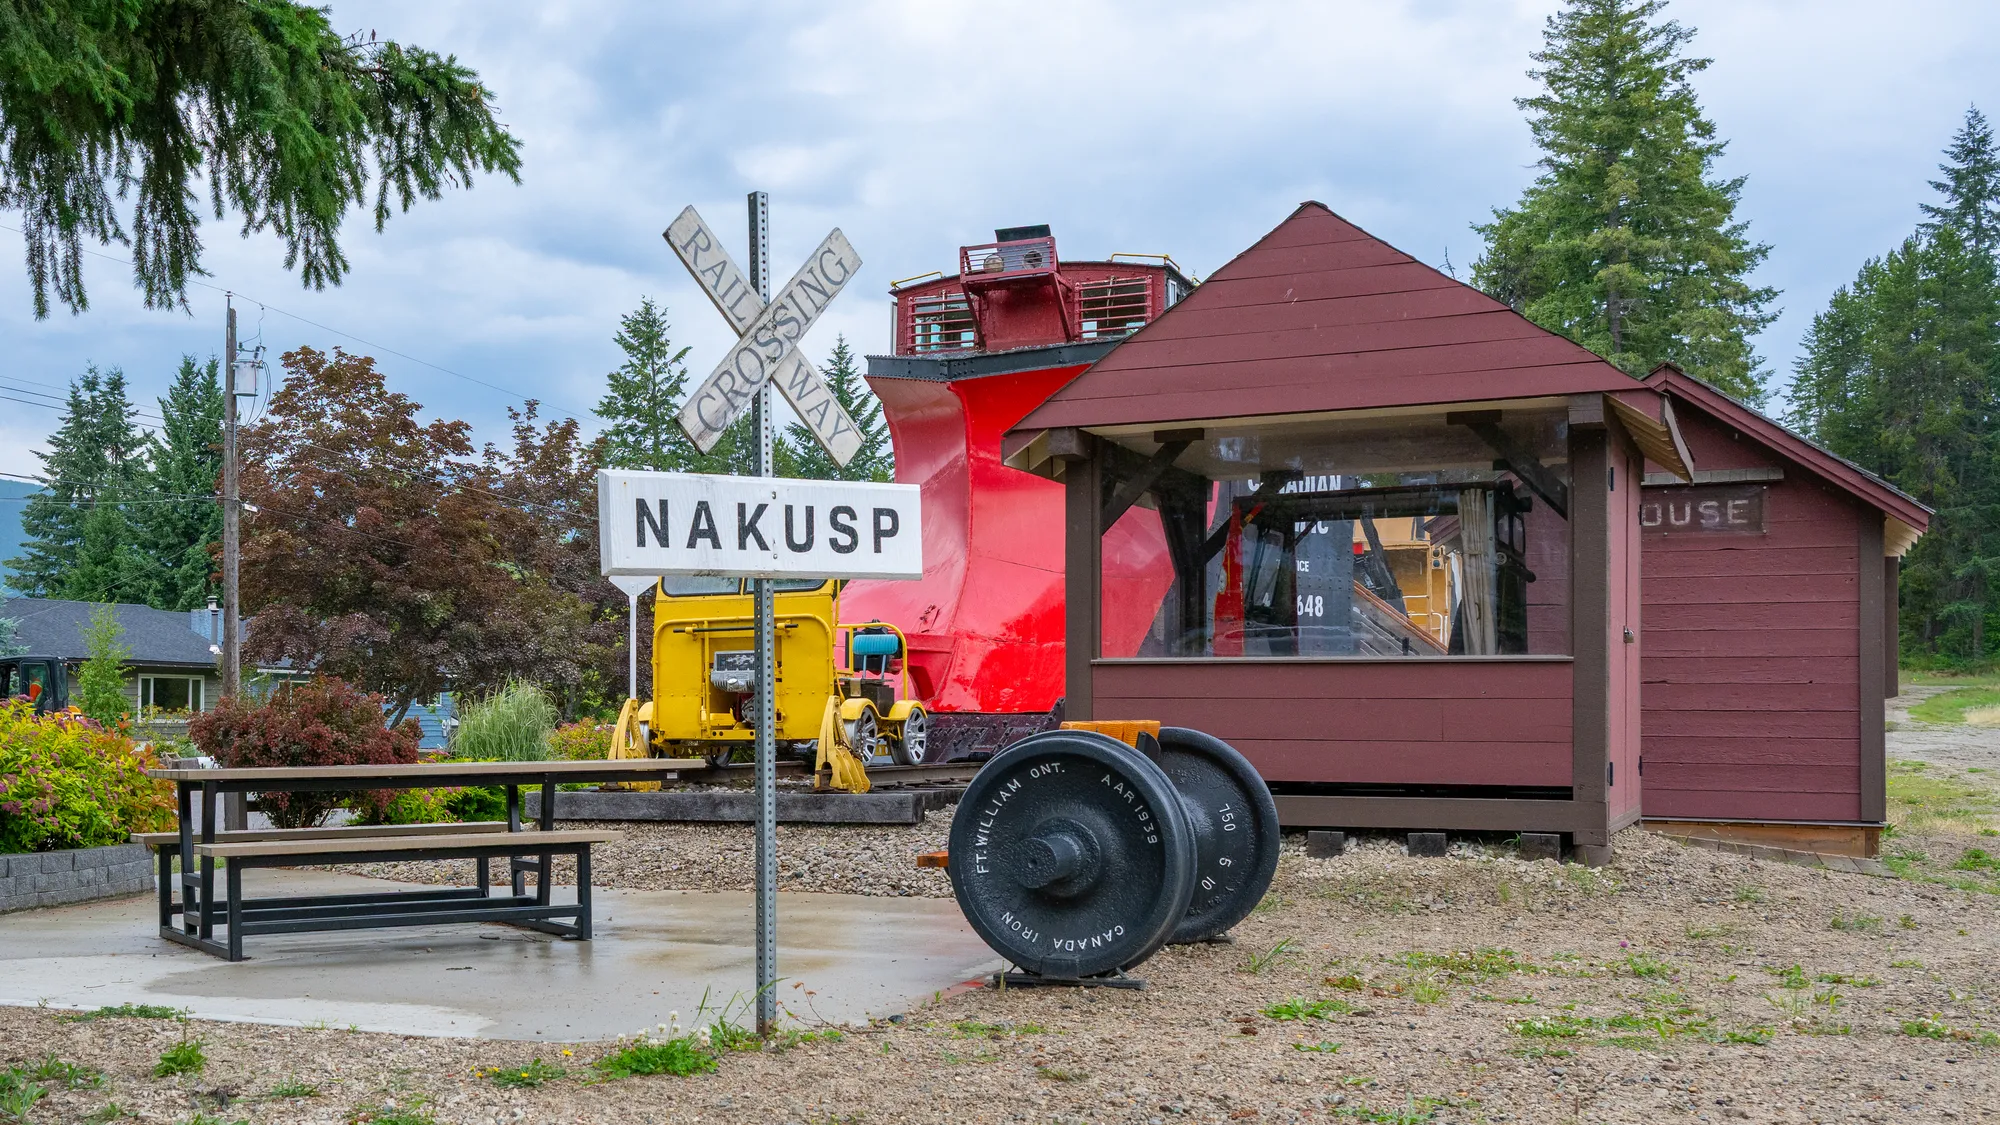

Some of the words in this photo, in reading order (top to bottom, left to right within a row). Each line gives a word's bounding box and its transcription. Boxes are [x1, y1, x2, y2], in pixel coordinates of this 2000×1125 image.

[680, 225, 753, 322] RAIL
[788, 359, 853, 447] WAY
[696, 247, 851, 433] CROSSING
[636, 498, 899, 553] NAKUSP
[1030, 763, 1065, 778] ONT.
[1135, 805, 1158, 844] 1939
[1219, 803, 1236, 832] 750
[1001, 912, 1039, 942] IRON
[1053, 925, 1124, 951] CANADA
